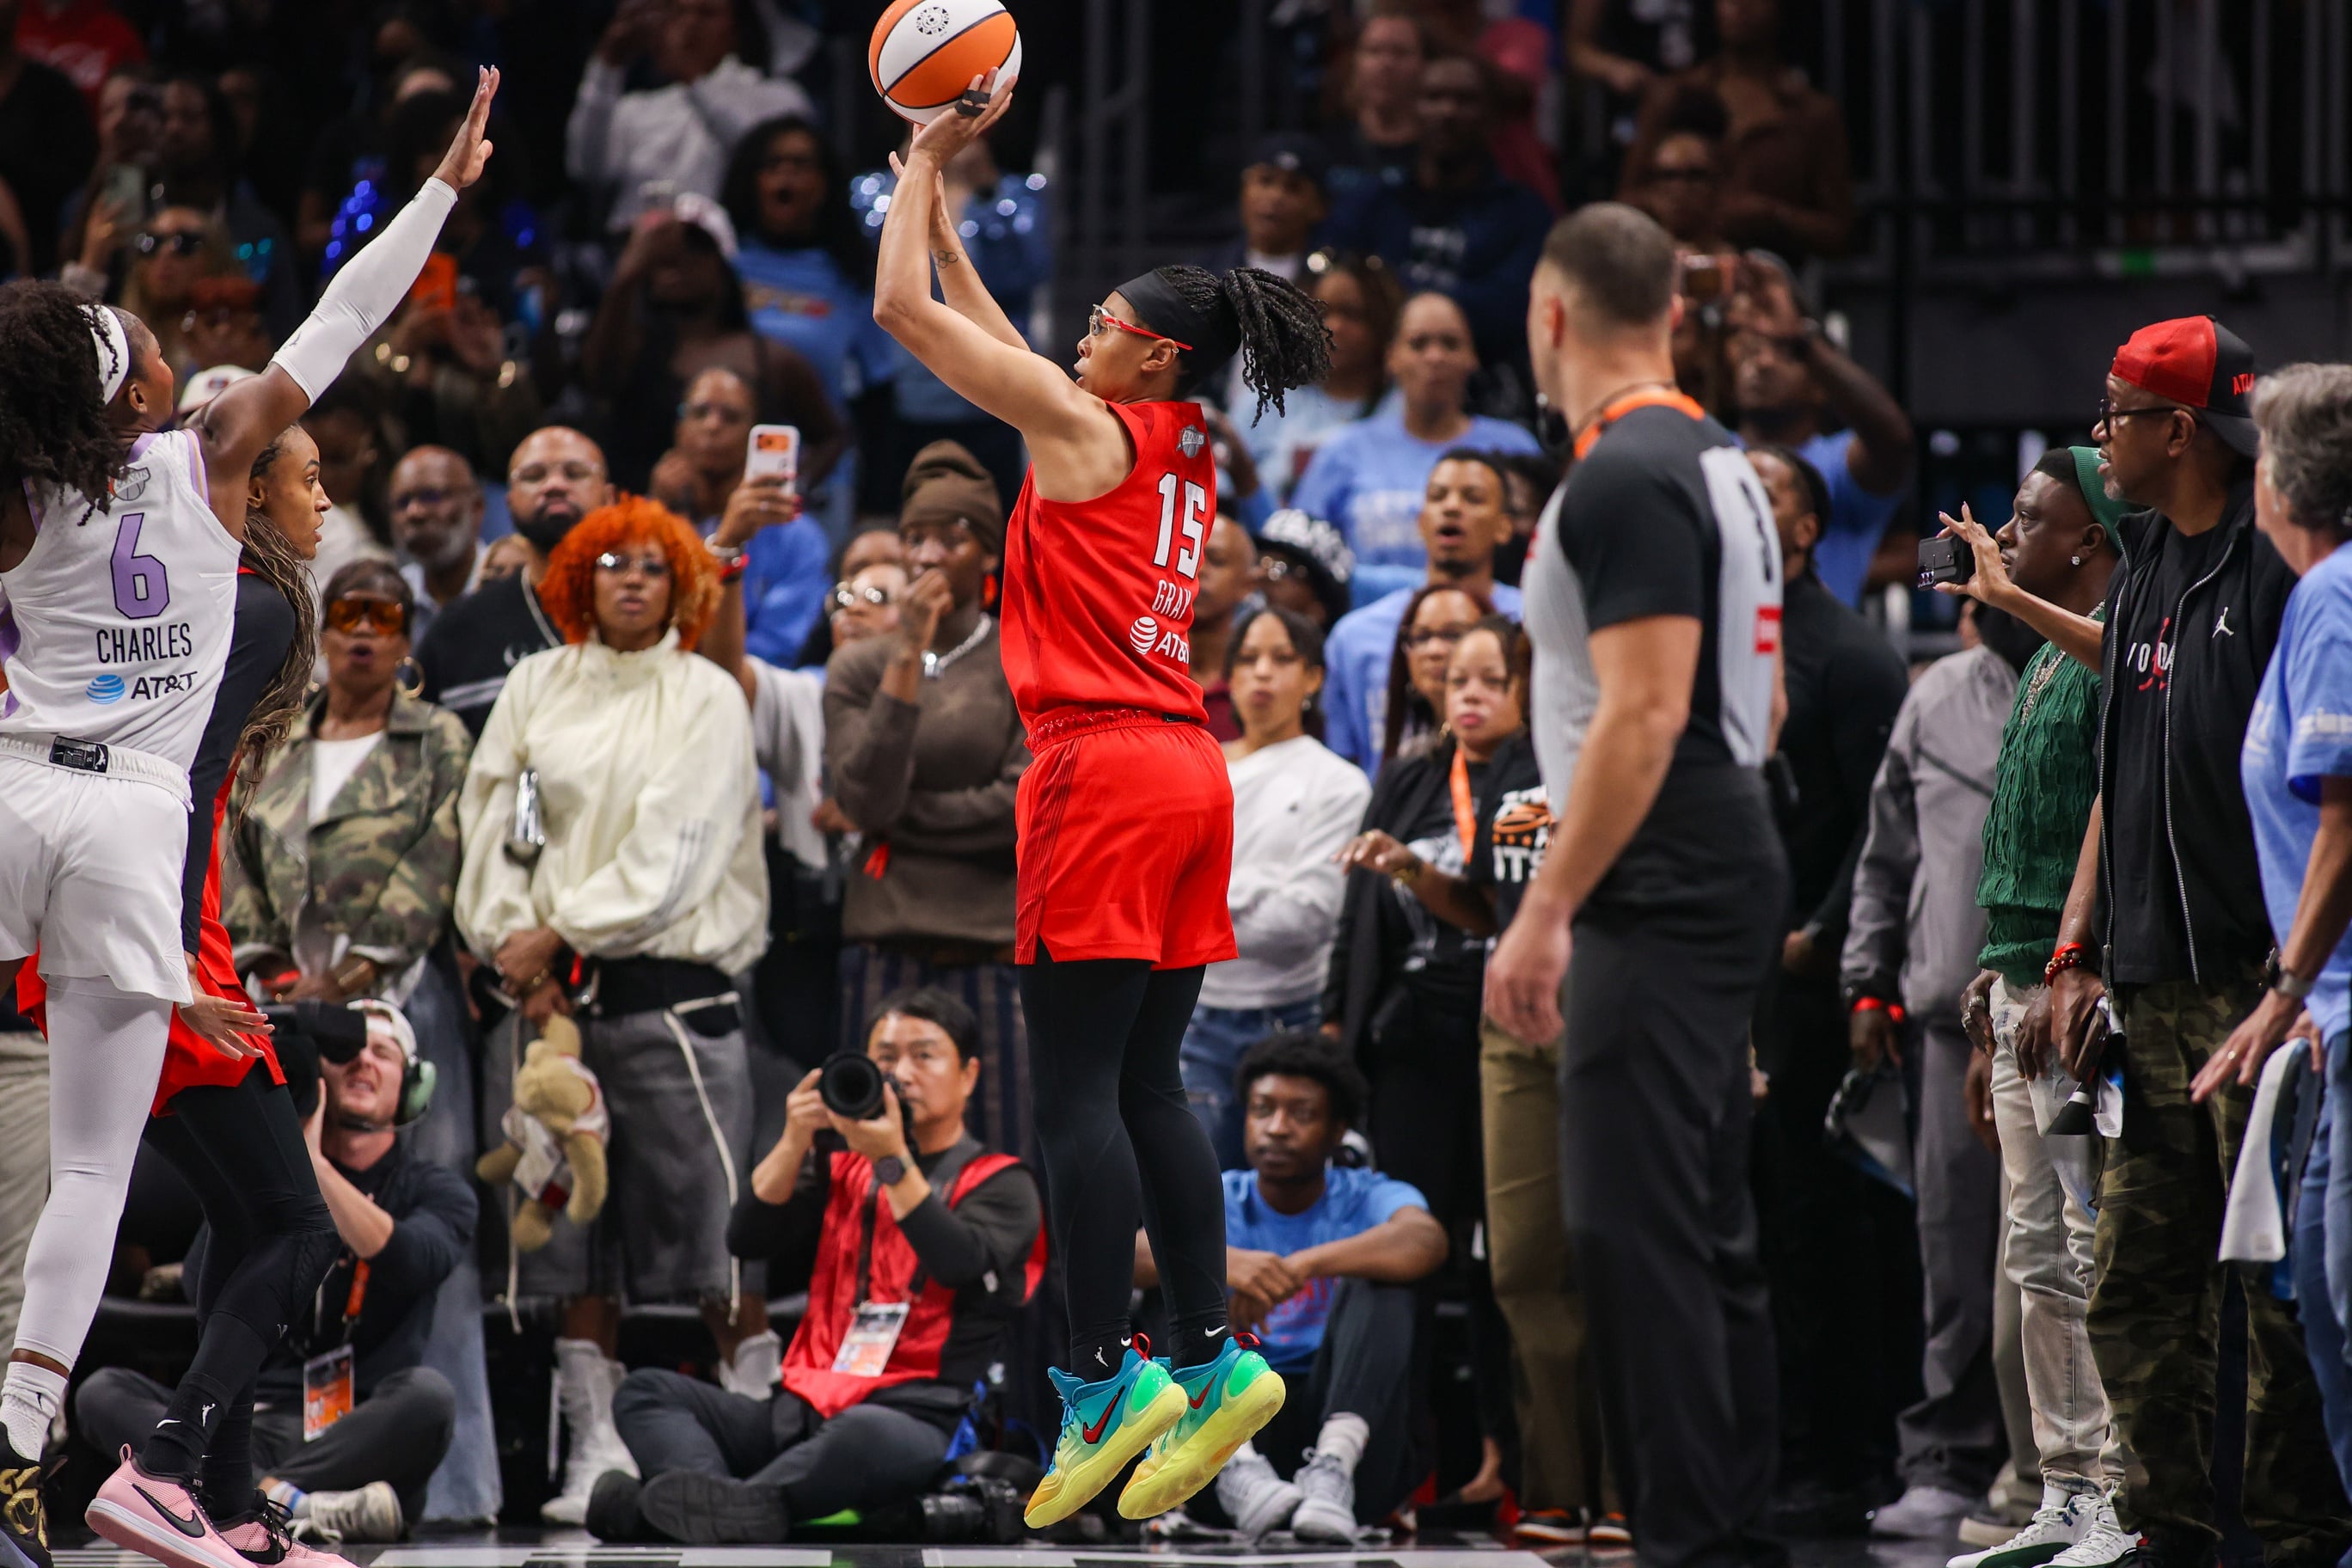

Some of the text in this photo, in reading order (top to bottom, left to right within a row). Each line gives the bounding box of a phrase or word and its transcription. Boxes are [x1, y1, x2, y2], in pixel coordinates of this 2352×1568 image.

[1153, 472, 1206, 580] 15
[110, 512, 170, 619] 6
[1152, 579, 1191, 621] GRAY
[96, 622, 192, 664] CHARLES
[131, 671, 198, 701] AT&T
